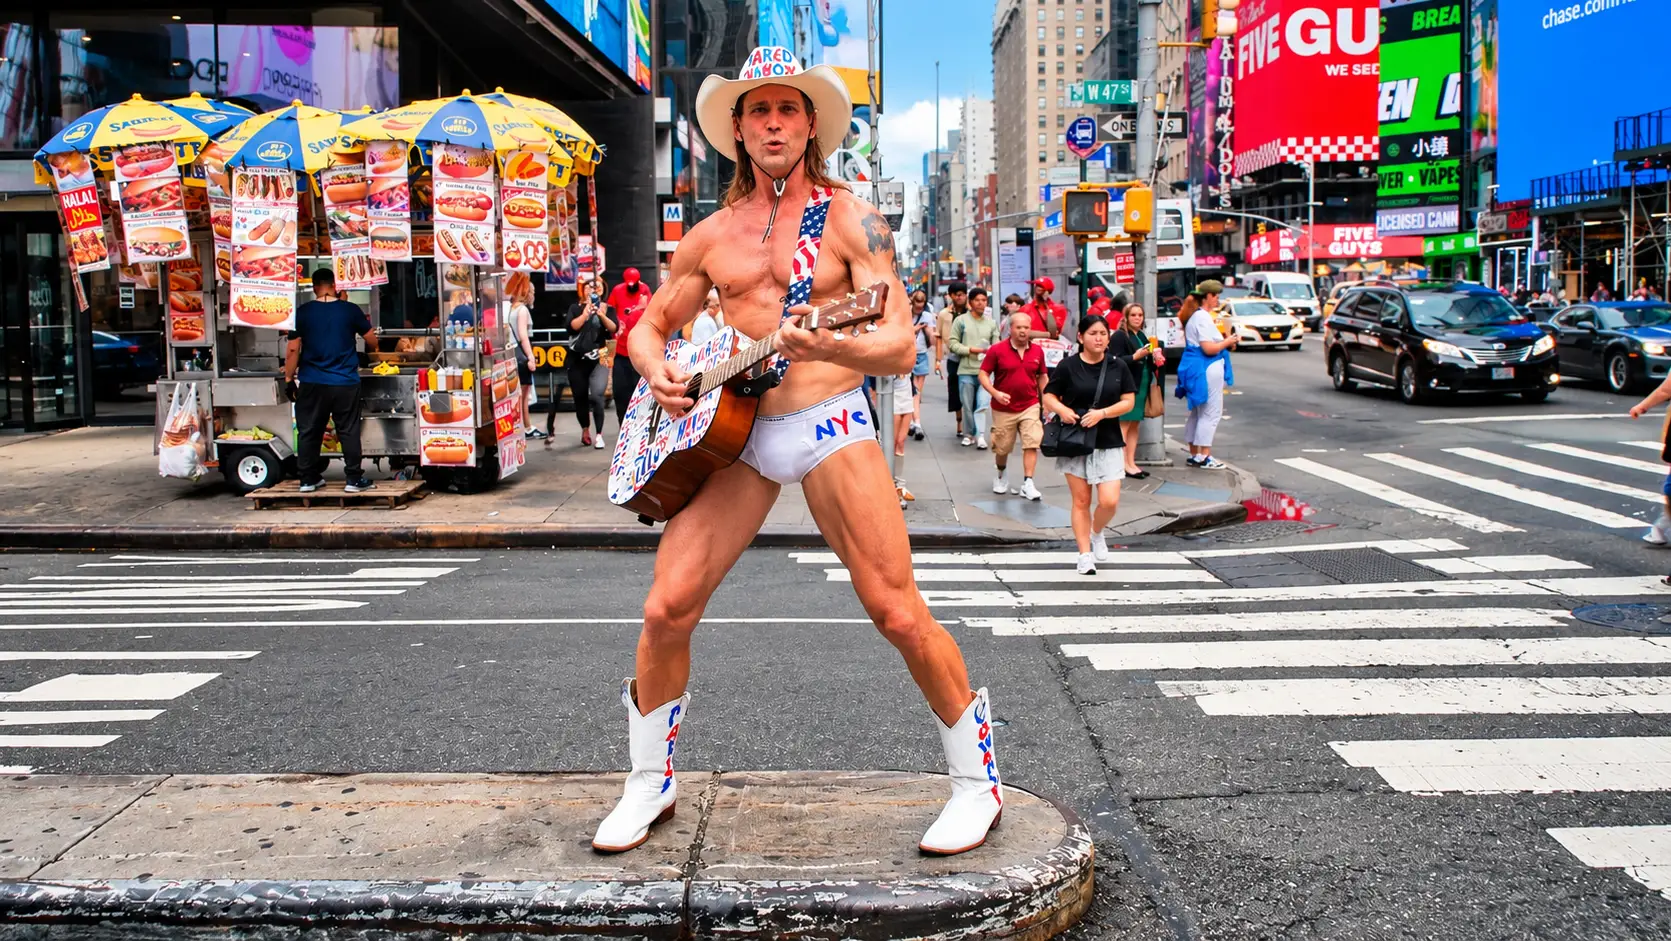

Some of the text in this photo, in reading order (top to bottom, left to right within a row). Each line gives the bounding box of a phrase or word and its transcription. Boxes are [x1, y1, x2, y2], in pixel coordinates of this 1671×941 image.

[1238, 12, 1280, 81] FIVE
[1285, 7, 1380, 57] GU
[1325, 64, 1349, 76] WE
[1088, 84, 1099, 100] W
[1102, 84, 1119, 100] 47
[1111, 121, 1136, 132] ONE
[666, 206, 680, 219] M
[1094, 201, 1106, 226] 4
[1427, 210, 1459, 228] CANN
[1333, 226, 1376, 241] FIVE
[1328, 241, 1383, 255] GUYS
[815, 409, 868, 441] NYC
